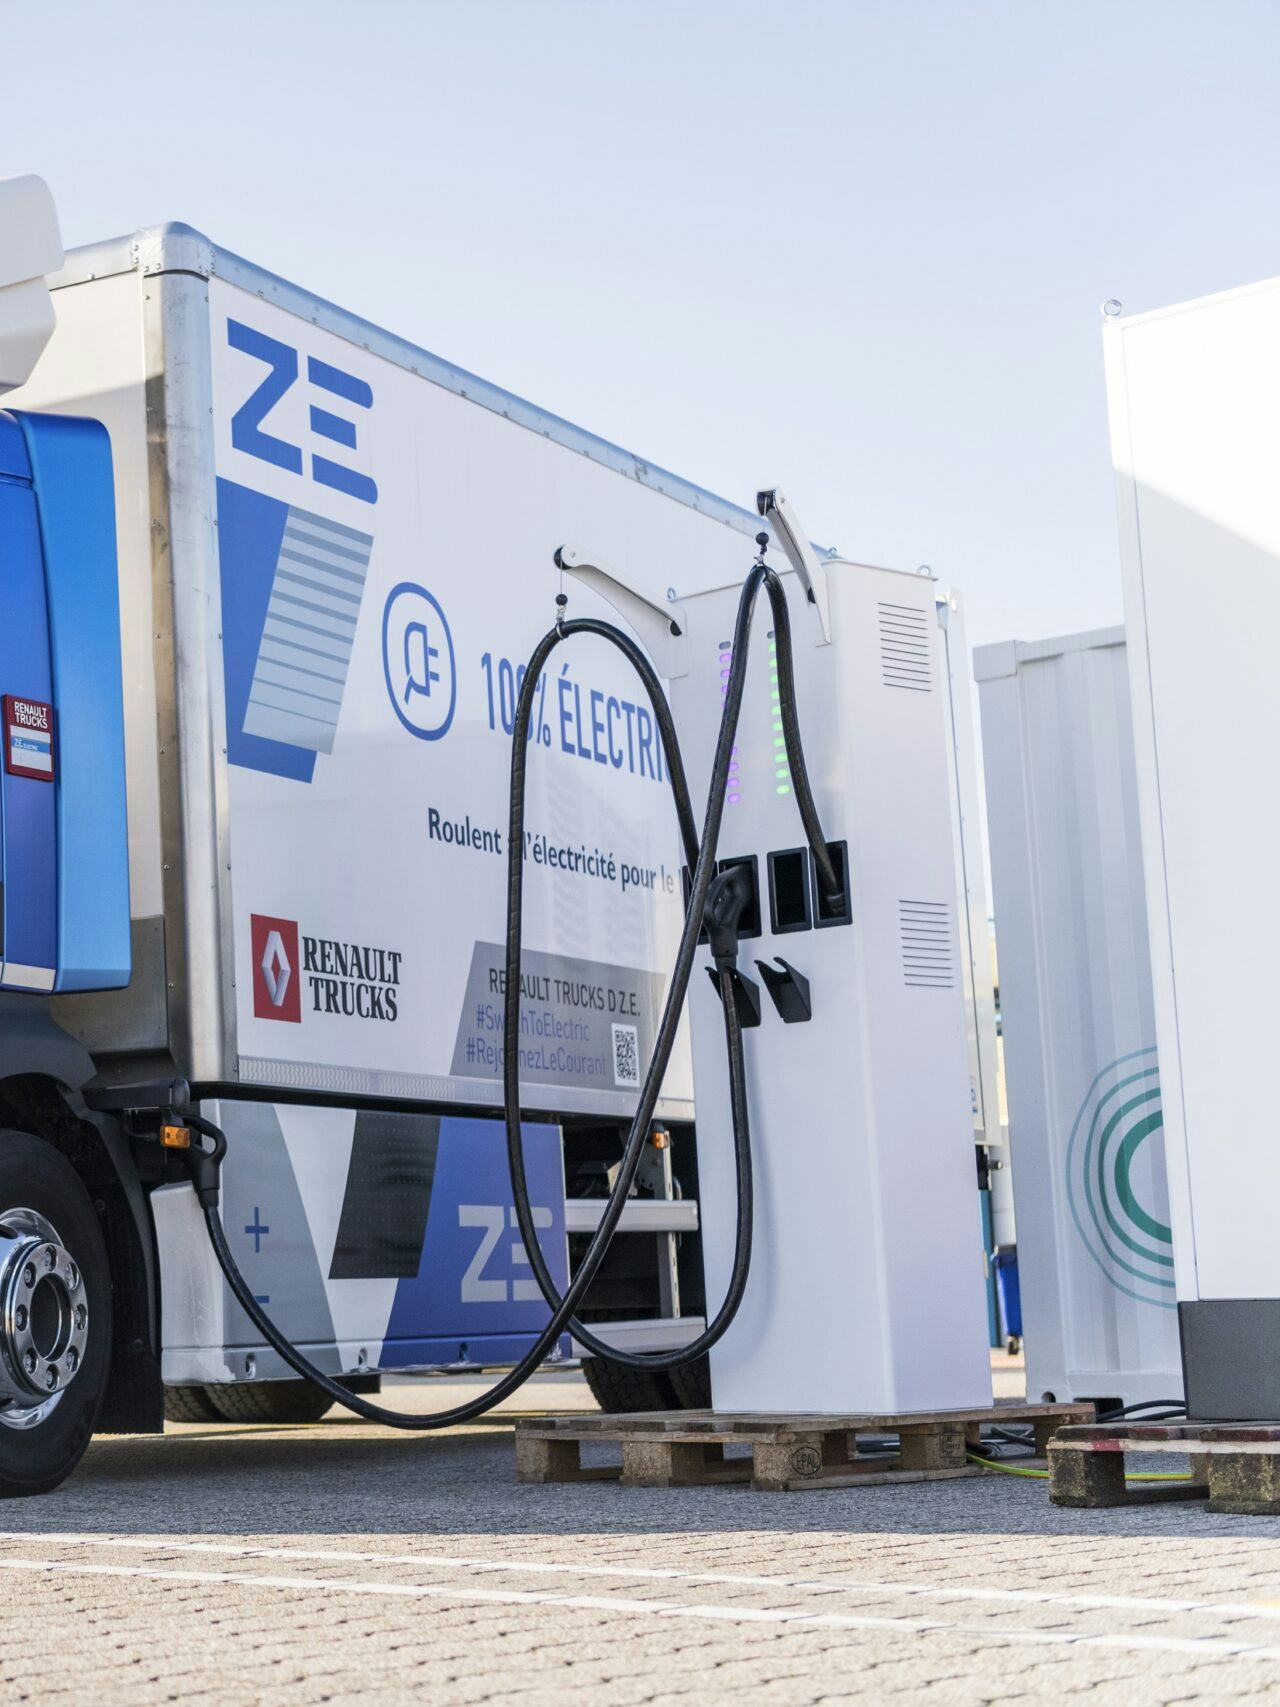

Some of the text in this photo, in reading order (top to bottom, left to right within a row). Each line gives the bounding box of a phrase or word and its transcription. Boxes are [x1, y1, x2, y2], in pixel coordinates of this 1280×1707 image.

[226, 317, 378, 505] ZE
[14, 701, 47, 718] RENAULT
[15, 712, 48, 729] TRUCKS
[557, 663, 671, 786] ÉLECTRI
[428, 807, 502, 855] Roulent
[620, 863, 657, 892] pour
[661, 865, 674, 893] le
[302, 936, 402, 985] RENAULT
[309, 976, 398, 1022] TRUCKS
[489, 968, 641, 1017] REAULT TRUCKS D Z.E.
